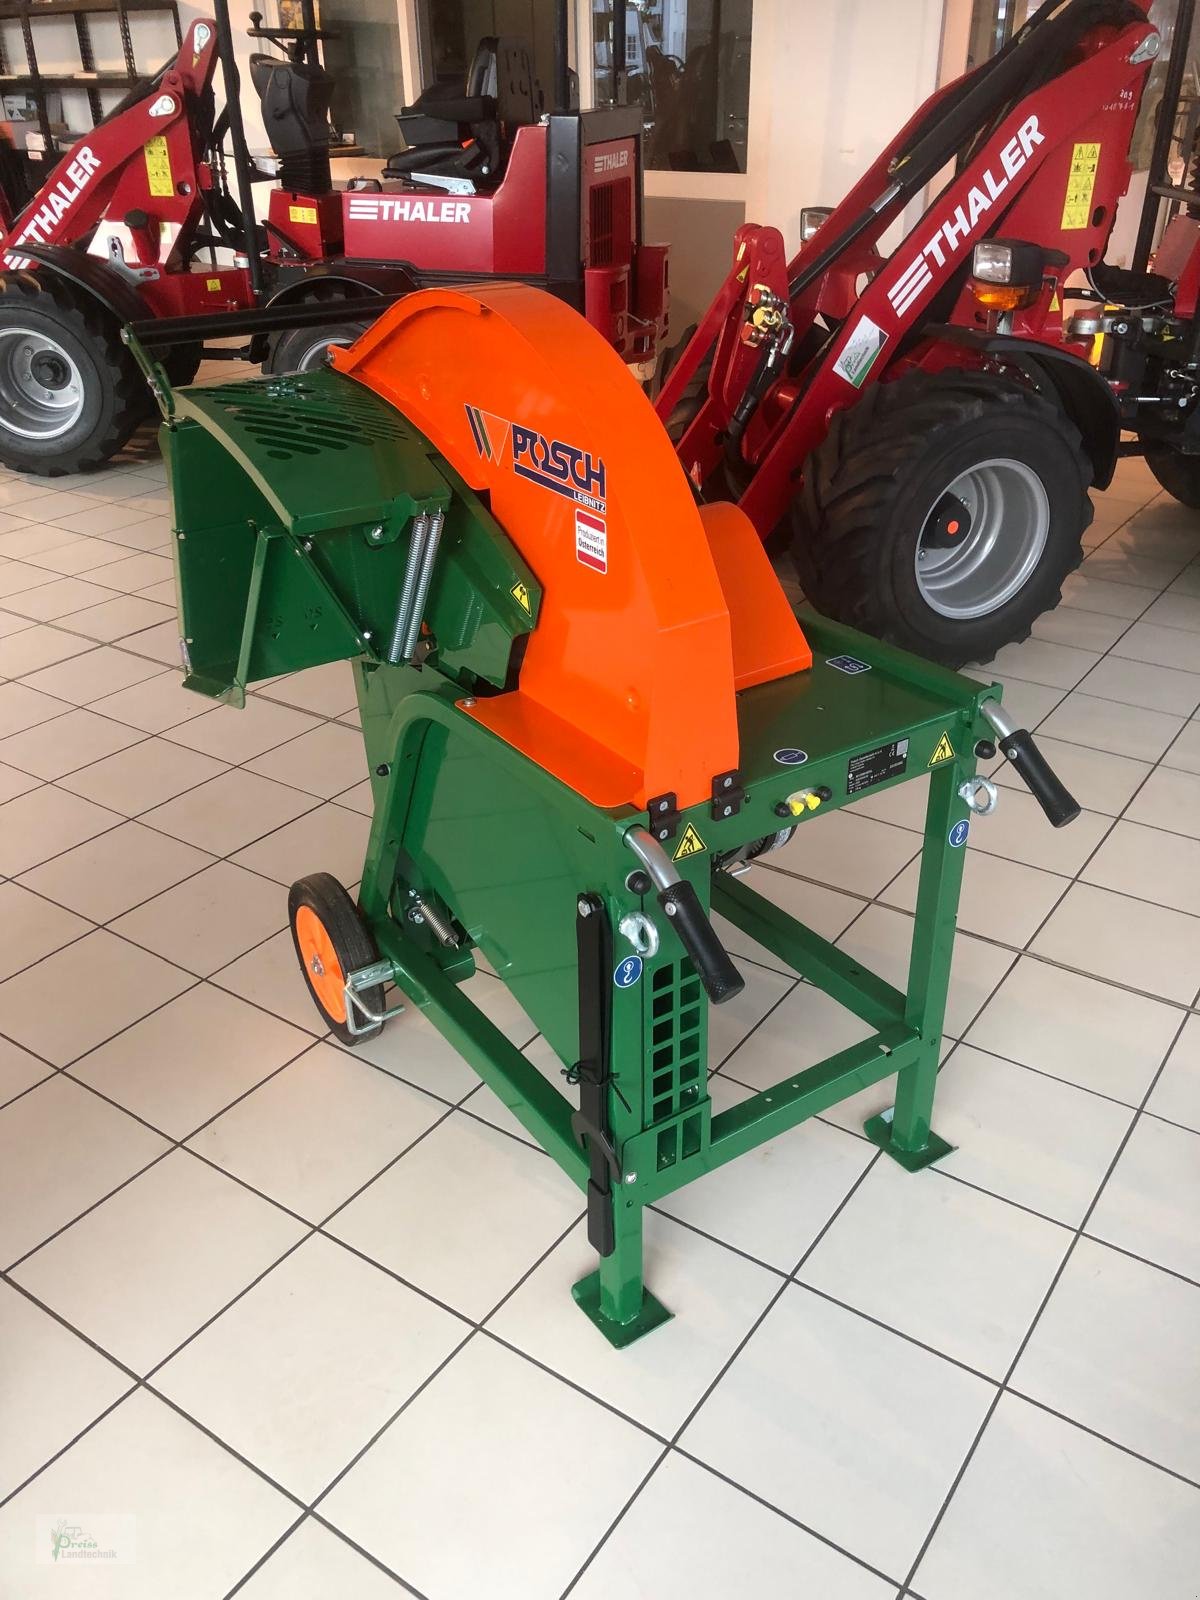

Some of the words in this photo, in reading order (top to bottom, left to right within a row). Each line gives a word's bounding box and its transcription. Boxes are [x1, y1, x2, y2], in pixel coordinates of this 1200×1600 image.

[604, 150, 628, 171] THALER
[24, 146, 101, 243] THALER
[923, 115, 1045, 267] THALER
[379, 201, 471, 223] THALER
[573, 491, 605, 512] LEIBNITZ
